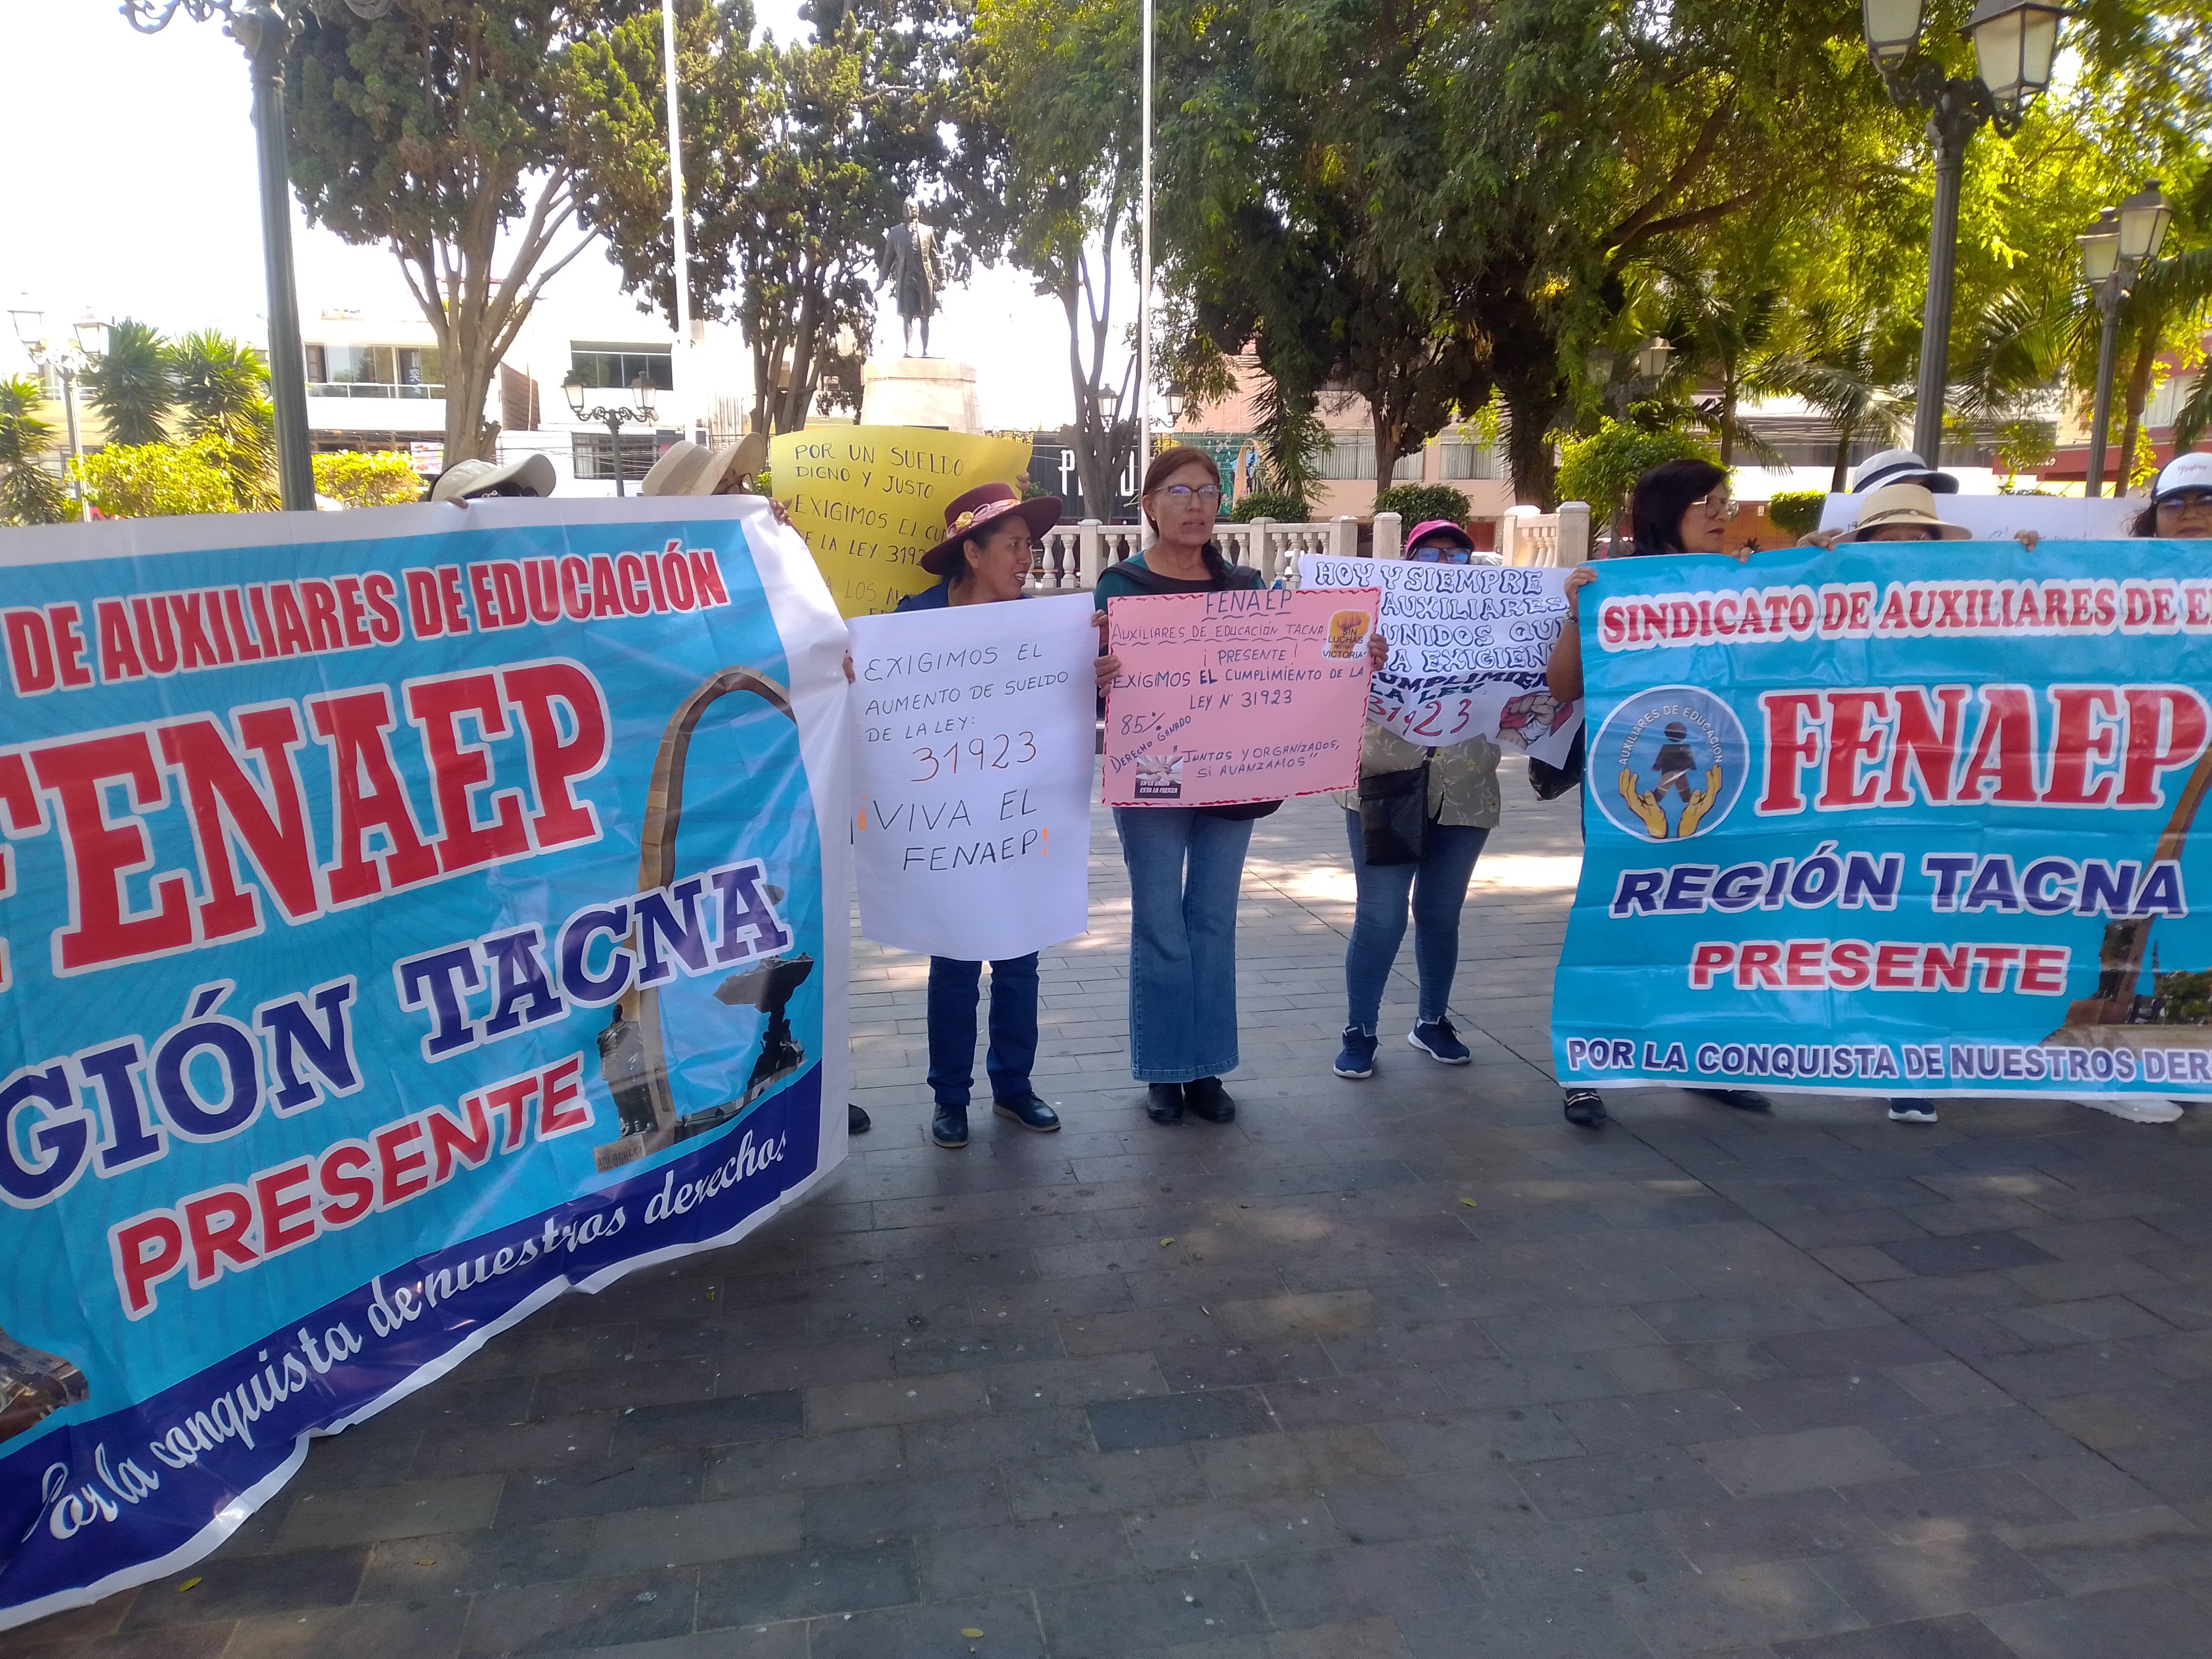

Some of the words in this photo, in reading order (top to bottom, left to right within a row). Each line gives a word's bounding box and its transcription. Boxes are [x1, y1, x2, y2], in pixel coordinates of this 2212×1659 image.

[795, 442, 835, 460] POR
[849, 444, 875, 464] UN
[890, 447, 963, 476] SUELDO
[795, 466, 851, 482] DIGNO
[861, 471, 873, 488] Y
[882, 475, 934, 499] JUSTO
[821, 534, 837, 551] LA
[898, 518, 917, 538] EL
[845, 580, 876, 601] LOS
[1316, 561, 1375, 588] HOY
[1381, 565, 1402, 590] Y
[1406, 566, 1543, 596] SIEMPRE
[4, 605, 91, 694] DE
[94, 573, 403, 681] AUXILIARES
[405, 567, 470, 638] DE
[470, 541, 729, 630] EDUCACIÓN
[1205, 589, 1293, 614] FENAEP
[1382, 592, 1568, 621] AUXILIARES
[1603, 592, 1815, 643] SINDICATO
[1822, 591, 1872, 631] DE
[1879, 588, 2116, 630] AUXILIARES
[2124, 588, 2177, 626] DE
[1192, 625, 1207, 638] DE
[1285, 623, 1324, 635] TACNA
[1328, 635, 1363, 644] LUCHAS
[1381, 623, 1495, 647] UNIDOS
[864, 647, 999, 682] EXIGIMOS
[1017, 643, 1042, 661] EL
[1421, 642, 1556, 672] EXIGIEN
[1199, 669, 1219, 685] EL
[1330, 668, 1344, 679] DE
[1349, 666, 1364, 678] LA
[865, 689, 960, 716] AUMENTO
[969, 684, 995, 700] DE
[1004, 671, 1069, 695] SUELDO
[1189, 693, 1213, 711] LEY
[1241, 689, 1293, 708] 31923
[865, 727, 891, 742] DE
[905, 722, 927, 740] LA
[1121, 711, 1166, 735] 85%
[1157, 715, 1191, 741] GANADO
[1619, 709, 1660, 766] AUXILIARES
[1663, 705, 1680, 715] DE
[910, 731, 1037, 782] 31923
[1242, 749, 1250, 761] Y
[1760, 688, 2207, 812] FENAEP
[1000, 789, 1037, 822] EL
[1613, 844, 1901, 914] REGIÓN
[1926, 857, 2184, 915] TACNA
[400, 865, 788, 1057] TACNA
[1693, 943, 2067, 992] PRESENTE
[1568, 1040, 1633, 1069] POR
[1644, 1042, 1687, 1072] LA
[1698, 1045, 1897, 1078] CONQUISTA
[1904, 1046, 1943, 1077] DE
[1950, 1047, 2135, 1080] NUESTROS
[118, 1057, 590, 1313] PRESENTE
[95, 1442, 160, 1504] la
[149, 1324, 363, 1469] conquista
[367, 1275, 423, 1337] de
[424, 1206, 626, 1308] nuestros
